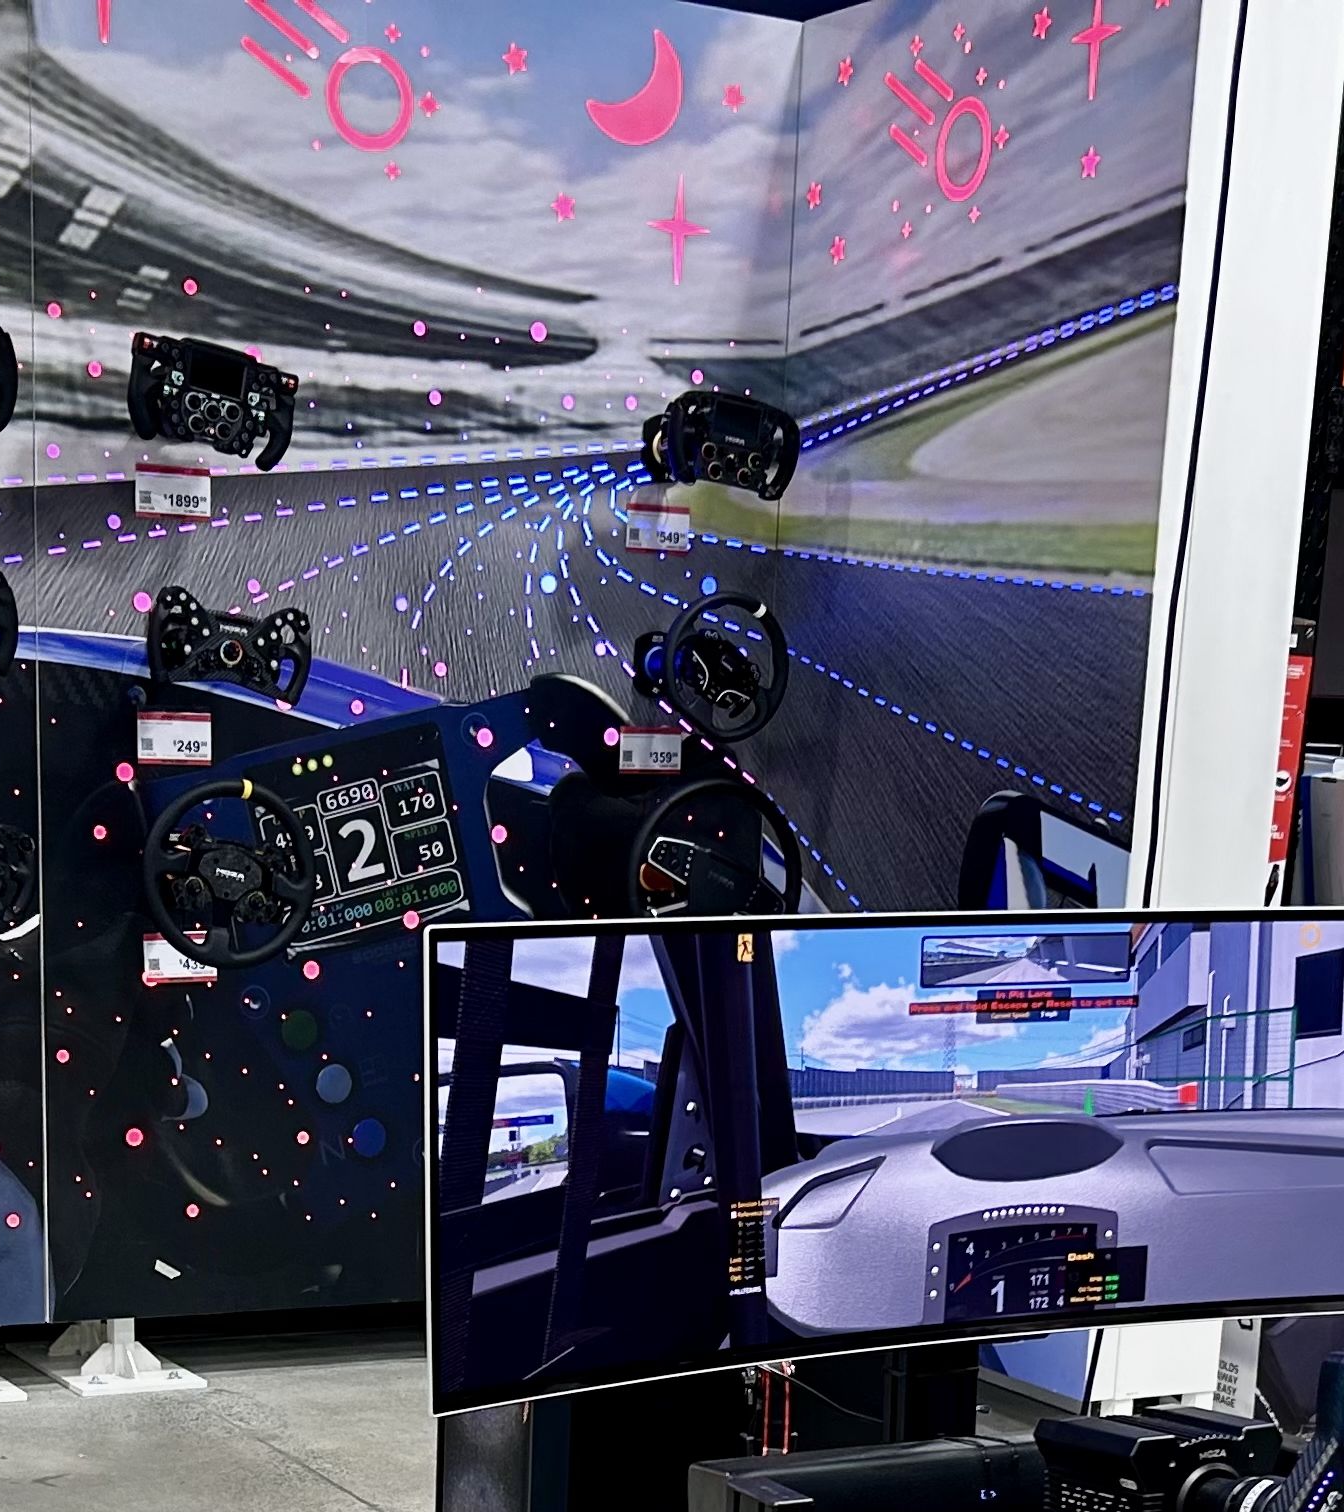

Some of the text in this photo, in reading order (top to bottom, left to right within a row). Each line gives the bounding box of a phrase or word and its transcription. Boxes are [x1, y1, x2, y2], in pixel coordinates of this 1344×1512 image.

[325, 783, 374, 810] 6690
[398, 793, 436, 817] 170
[338, 818, 386, 883] 2
[418, 841, 444, 861] 50
[375, 880, 458, 913] 00:01:000
[302, 902, 373, 933] 0:01:000
[991, 1001, 1029, 1011] Escape
[1030, 1273, 1050, 1287] 171
[990, 1280, 1005, 1313] 1
[1029, 1297, 1049, 1309] 172
[1219, 1360, 1239, 1374] OLDS
[1199, 1449, 1227, 1460] MOZA
